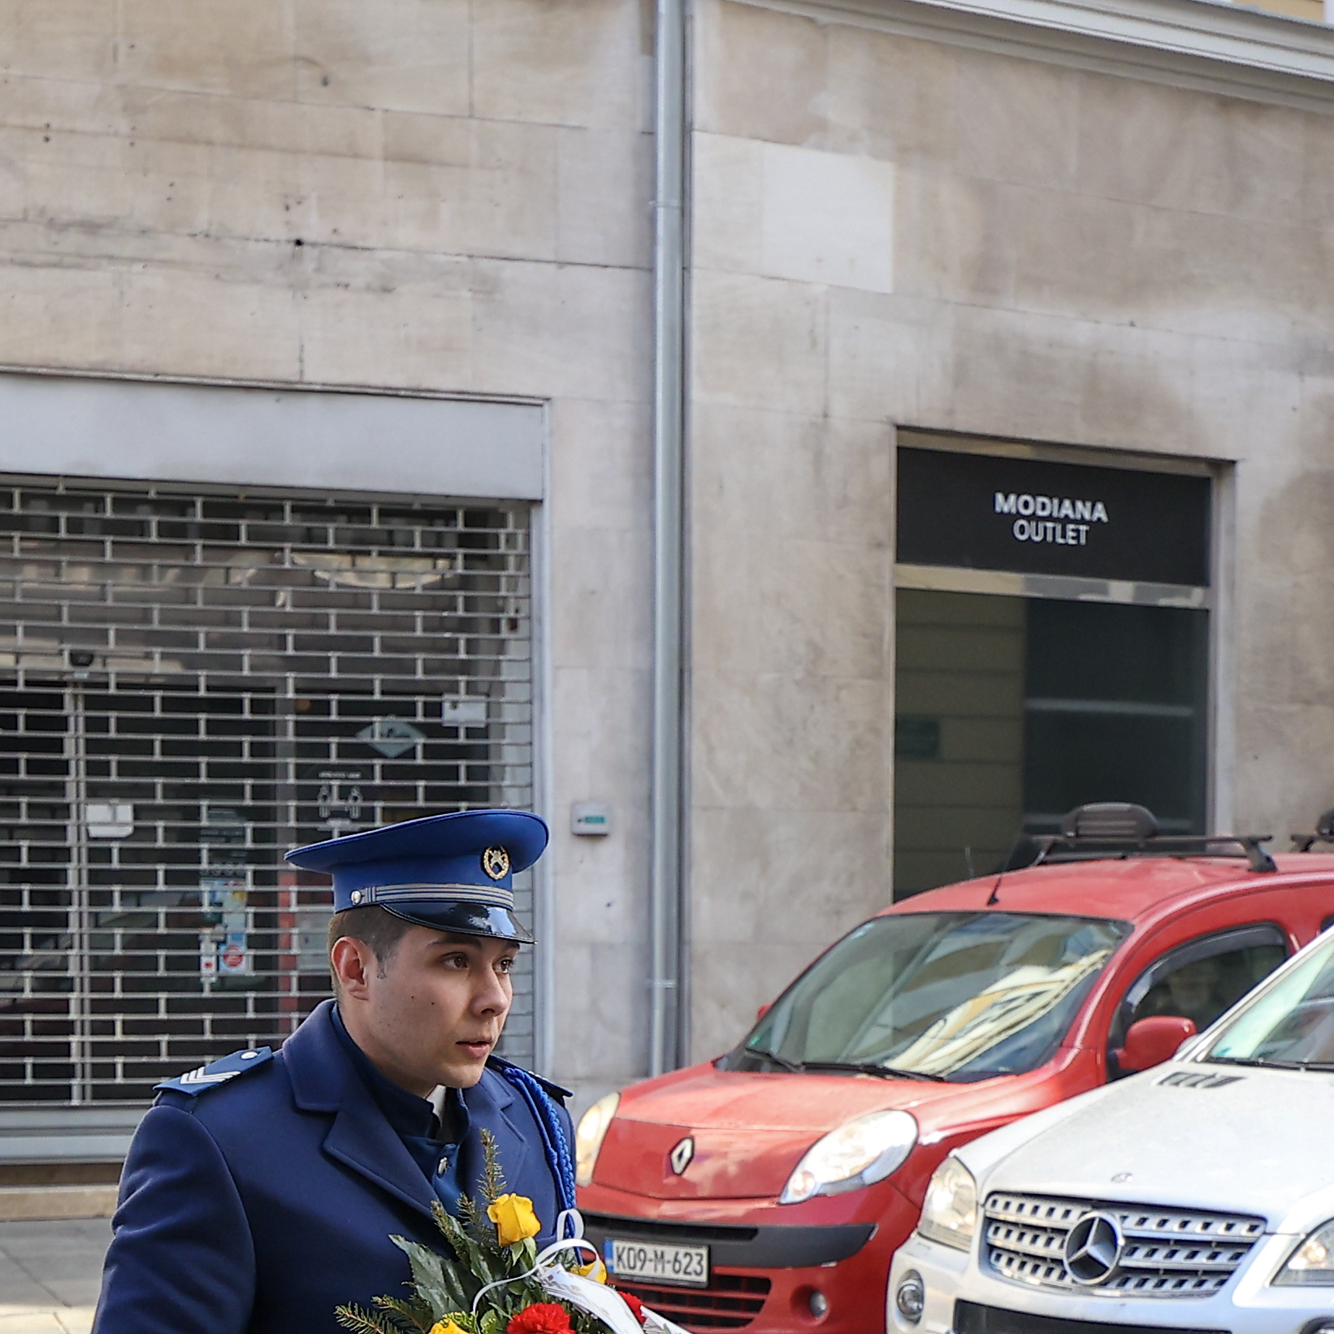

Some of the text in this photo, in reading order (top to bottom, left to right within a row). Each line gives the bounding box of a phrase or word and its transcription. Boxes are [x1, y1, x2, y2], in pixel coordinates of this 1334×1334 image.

[993, 492, 1109, 523] MODIANA
[1013, 519, 1090, 546] OUTLET
[615, 1246, 705, 1277] K09-M-623
